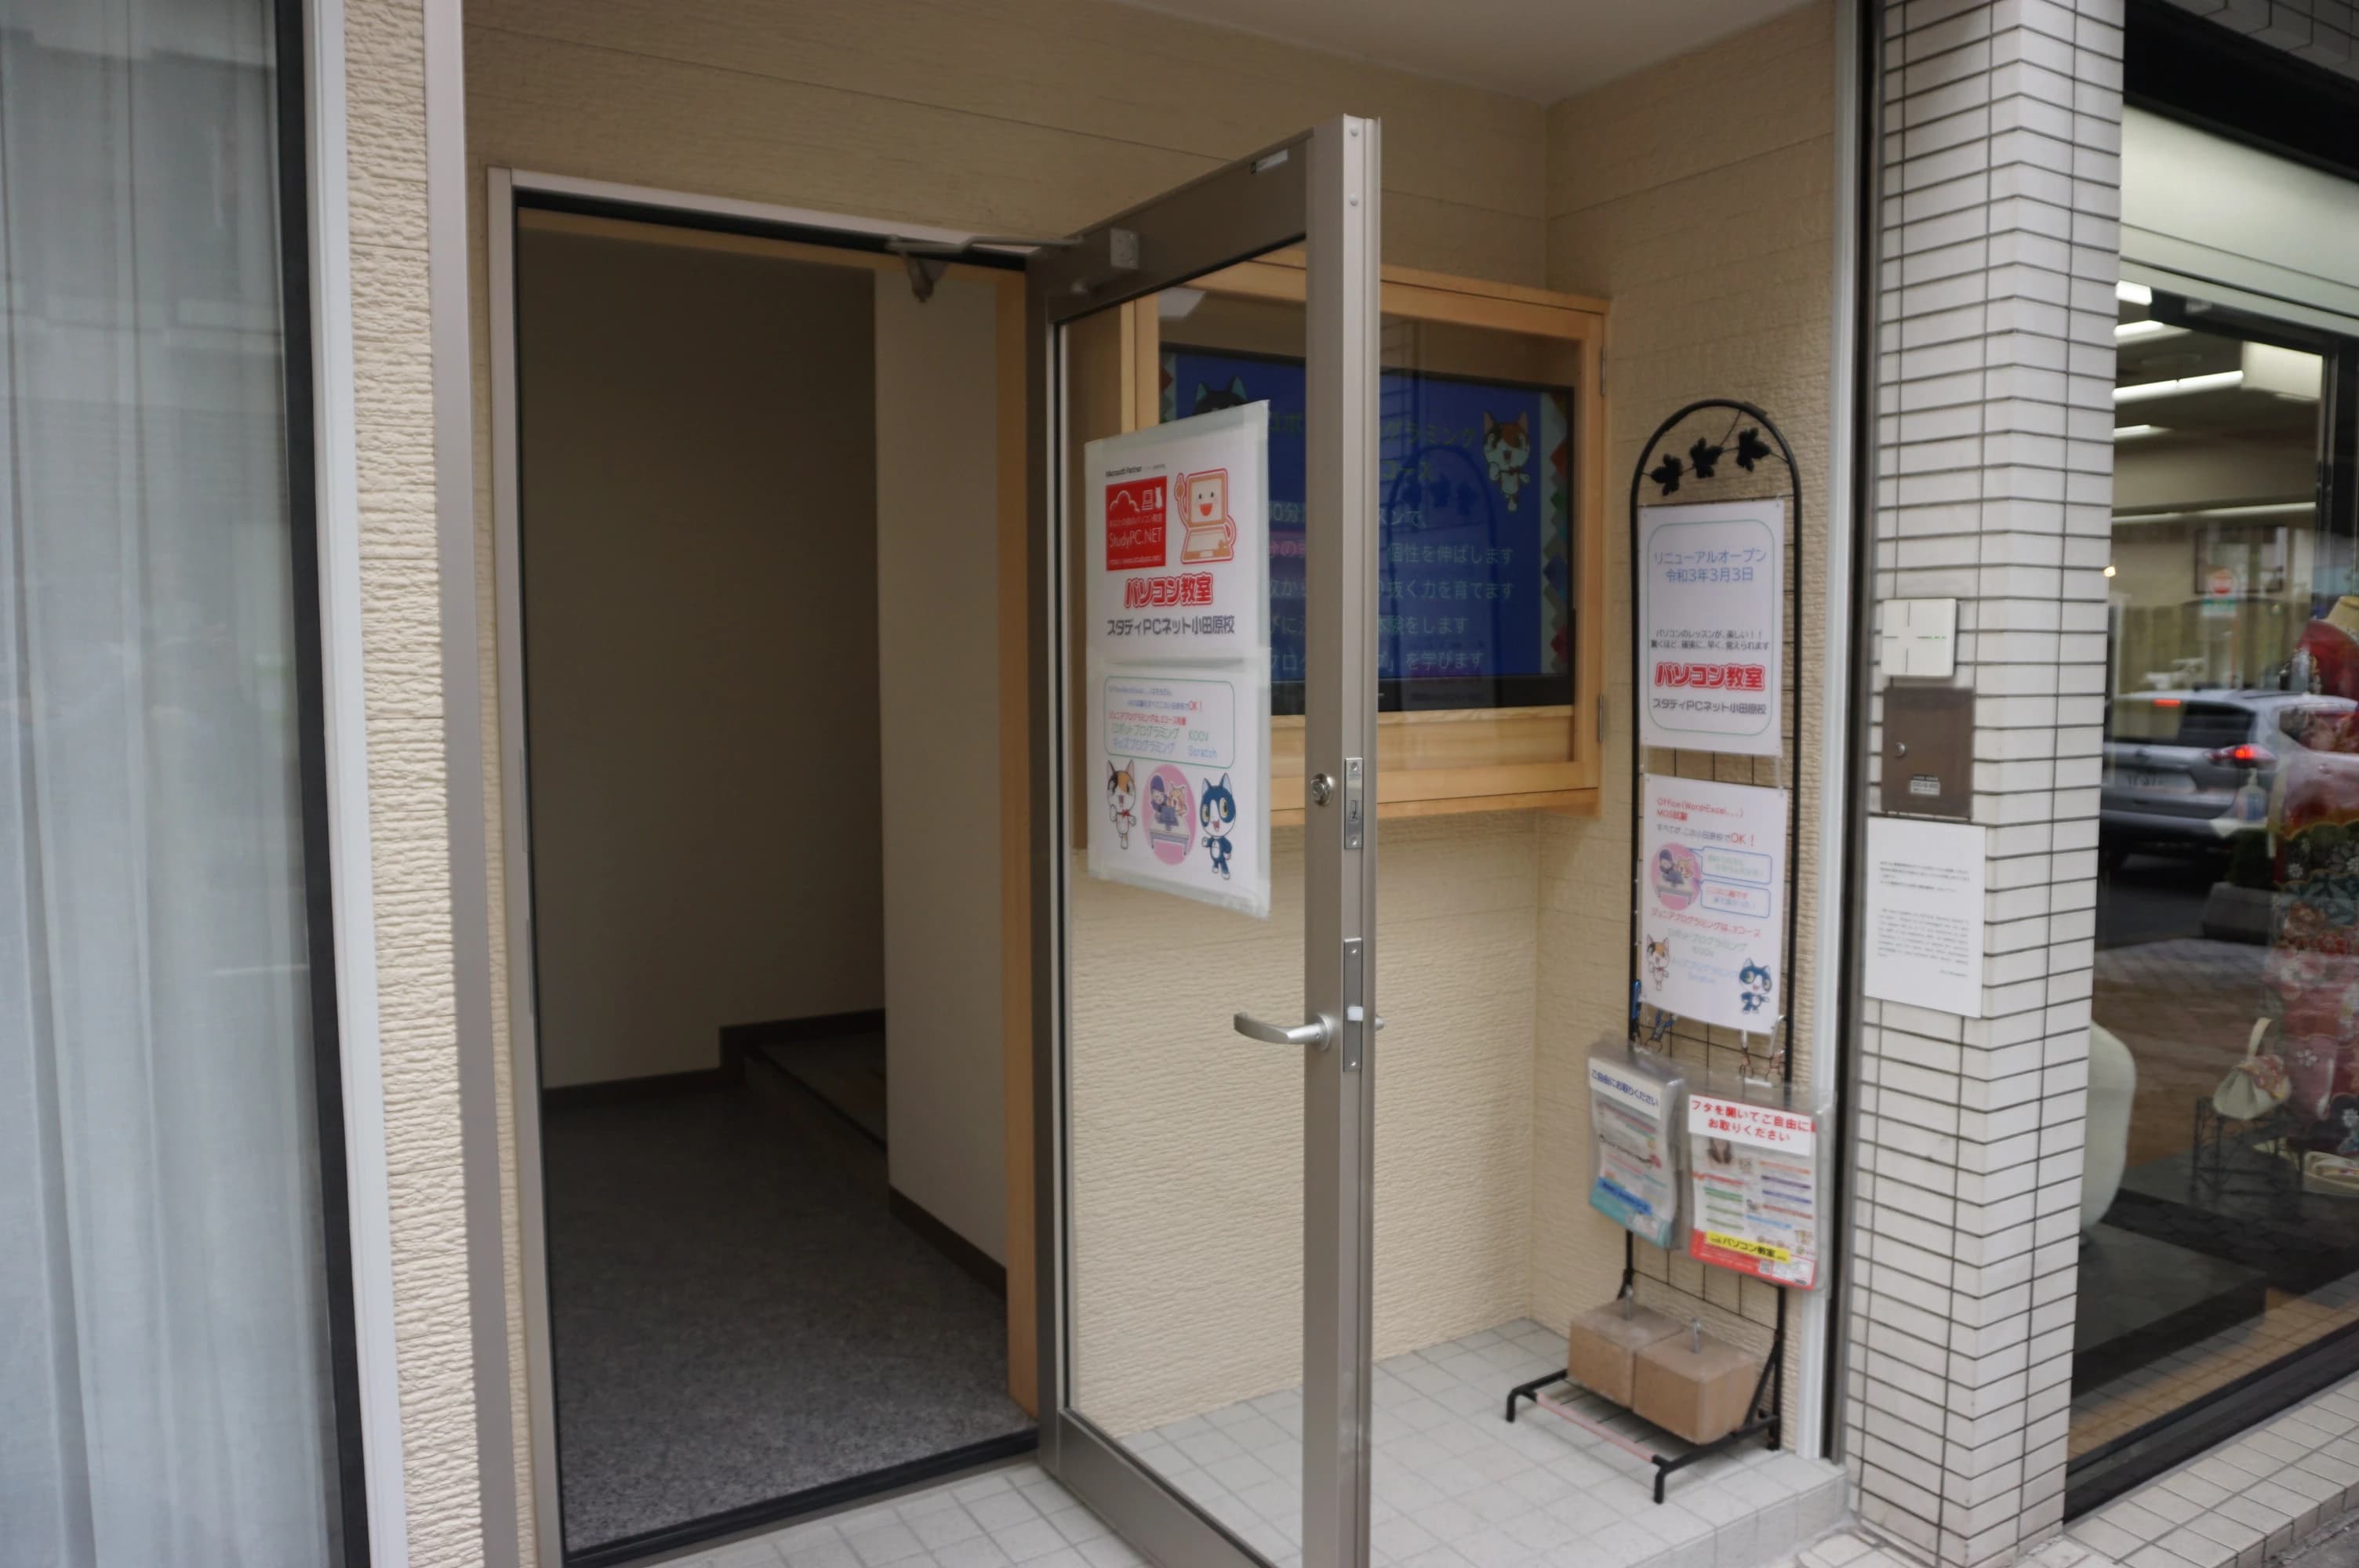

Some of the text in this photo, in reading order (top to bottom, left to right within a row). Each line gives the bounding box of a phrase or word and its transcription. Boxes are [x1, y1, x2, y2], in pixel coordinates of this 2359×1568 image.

[1654, 547, 1767, 565] リニューアルオープン
[1666, 566, 1754, 584] 令和3年3月3日
[1124, 572, 1214, 608] パソコン教室
[1107, 615, 1236, 636] スタディPCネット小田原校
[1654, 661, 1765, 691] パソコン教室
[1692, 1101, 1809, 1131] フタを開いてご自由に
[1708, 1118, 1790, 1142] お取りください
